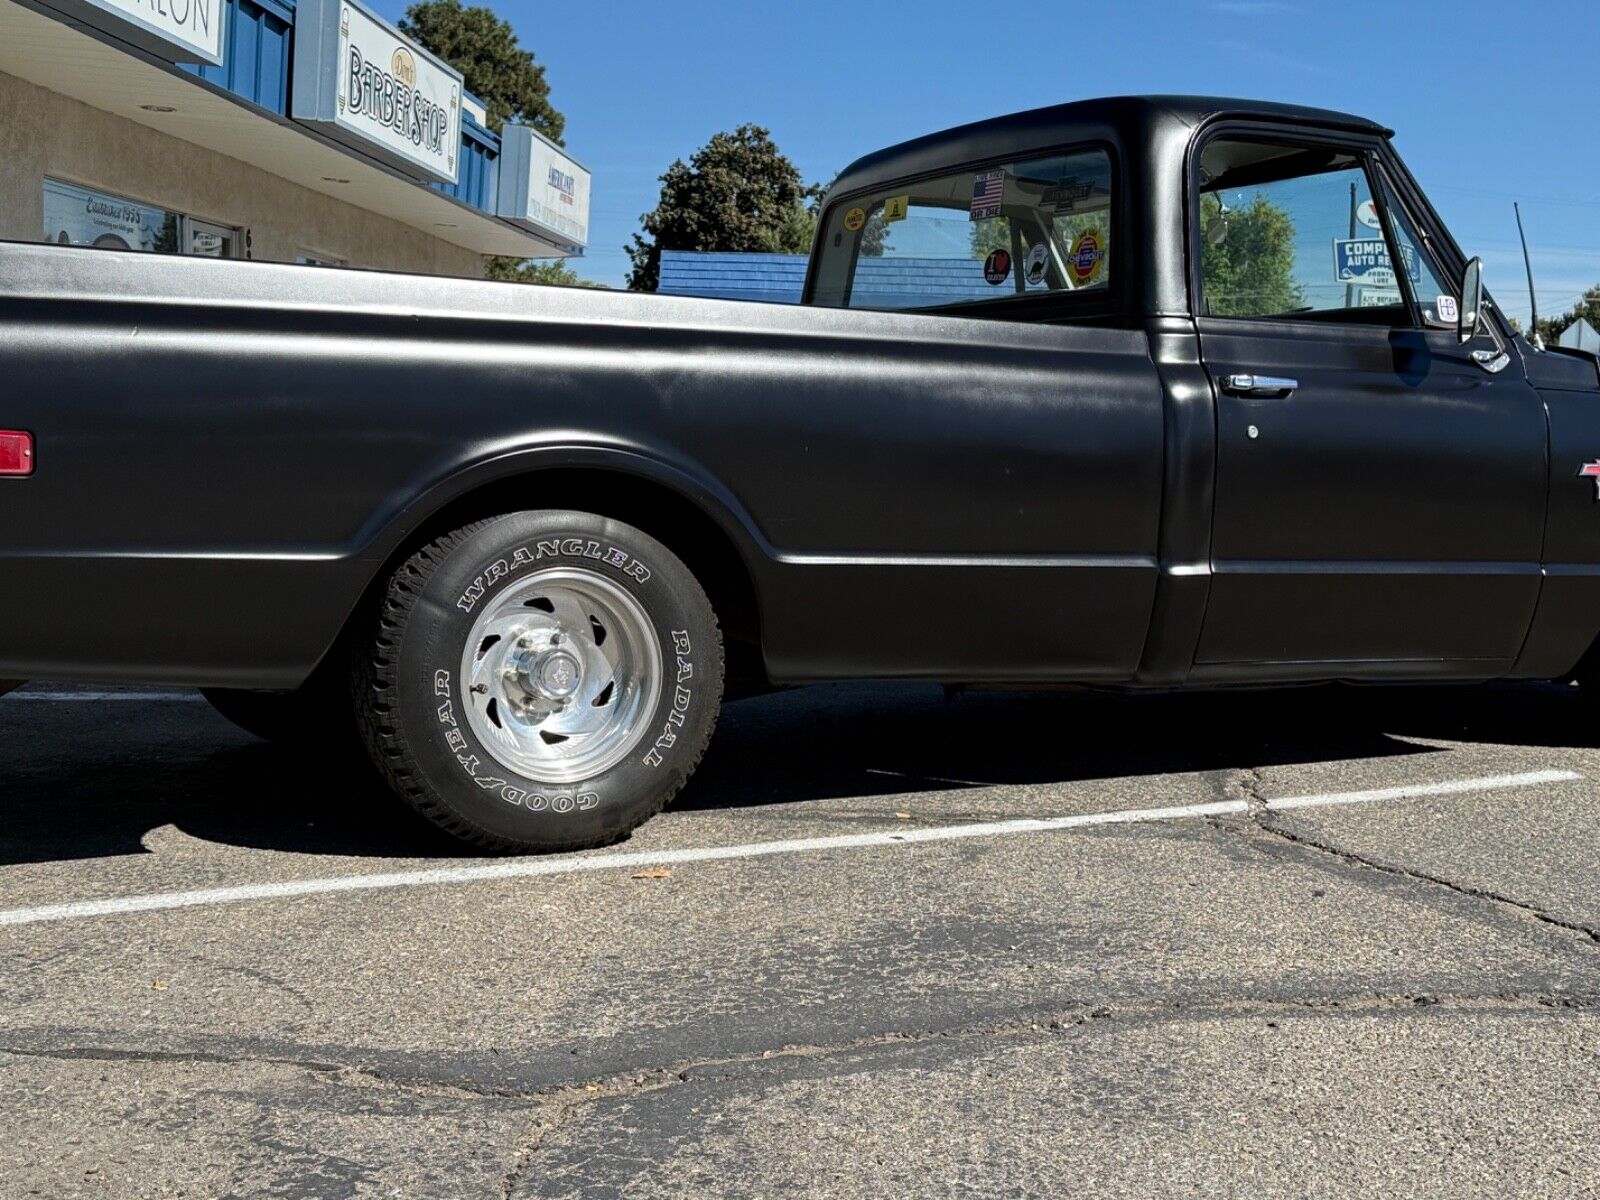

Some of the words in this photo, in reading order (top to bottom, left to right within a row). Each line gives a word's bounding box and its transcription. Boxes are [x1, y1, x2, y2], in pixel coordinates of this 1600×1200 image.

[1347, 255, 1375, 266] AUTO
[457, 539, 651, 613] WRANGLER
[642, 630, 693, 767] RADIAL
